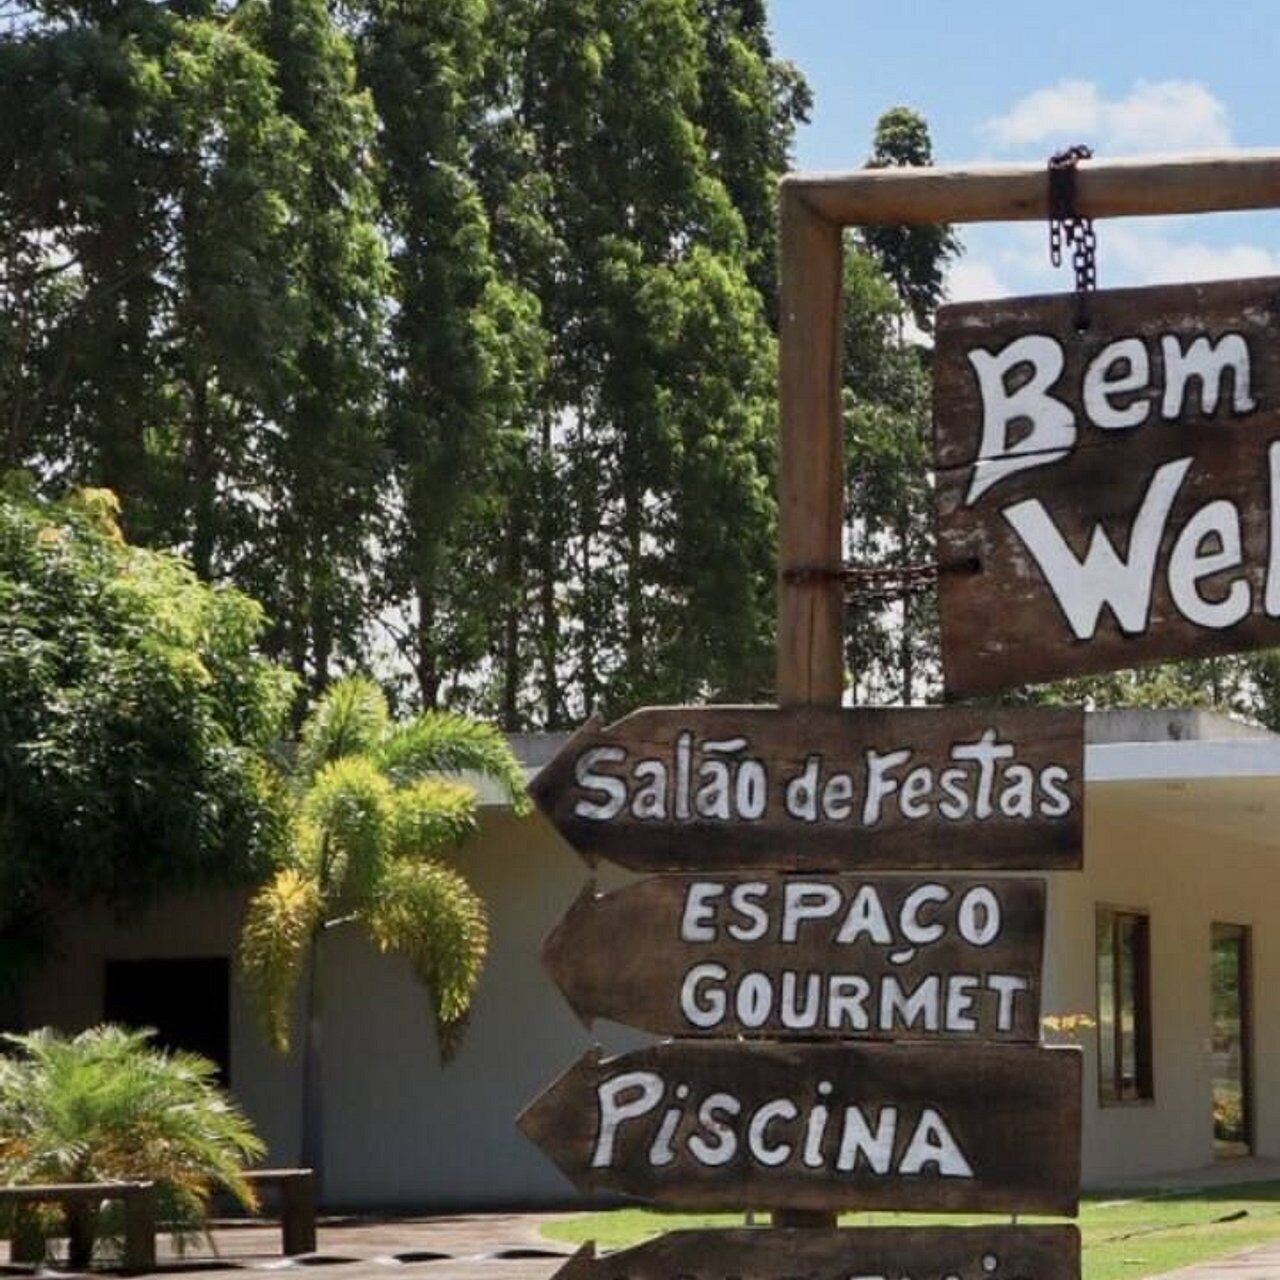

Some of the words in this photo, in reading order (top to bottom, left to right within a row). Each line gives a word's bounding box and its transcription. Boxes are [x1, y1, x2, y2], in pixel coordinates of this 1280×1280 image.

[966, 334, 1256, 505] Bem
[574, 732, 766, 820] Salão
[786, 757, 851, 820] de
[863, 729, 1070, 825] Festas
[680, 883, 1000, 963] ESPAÇO
[681, 963, 1026, 1031] GOURMET
